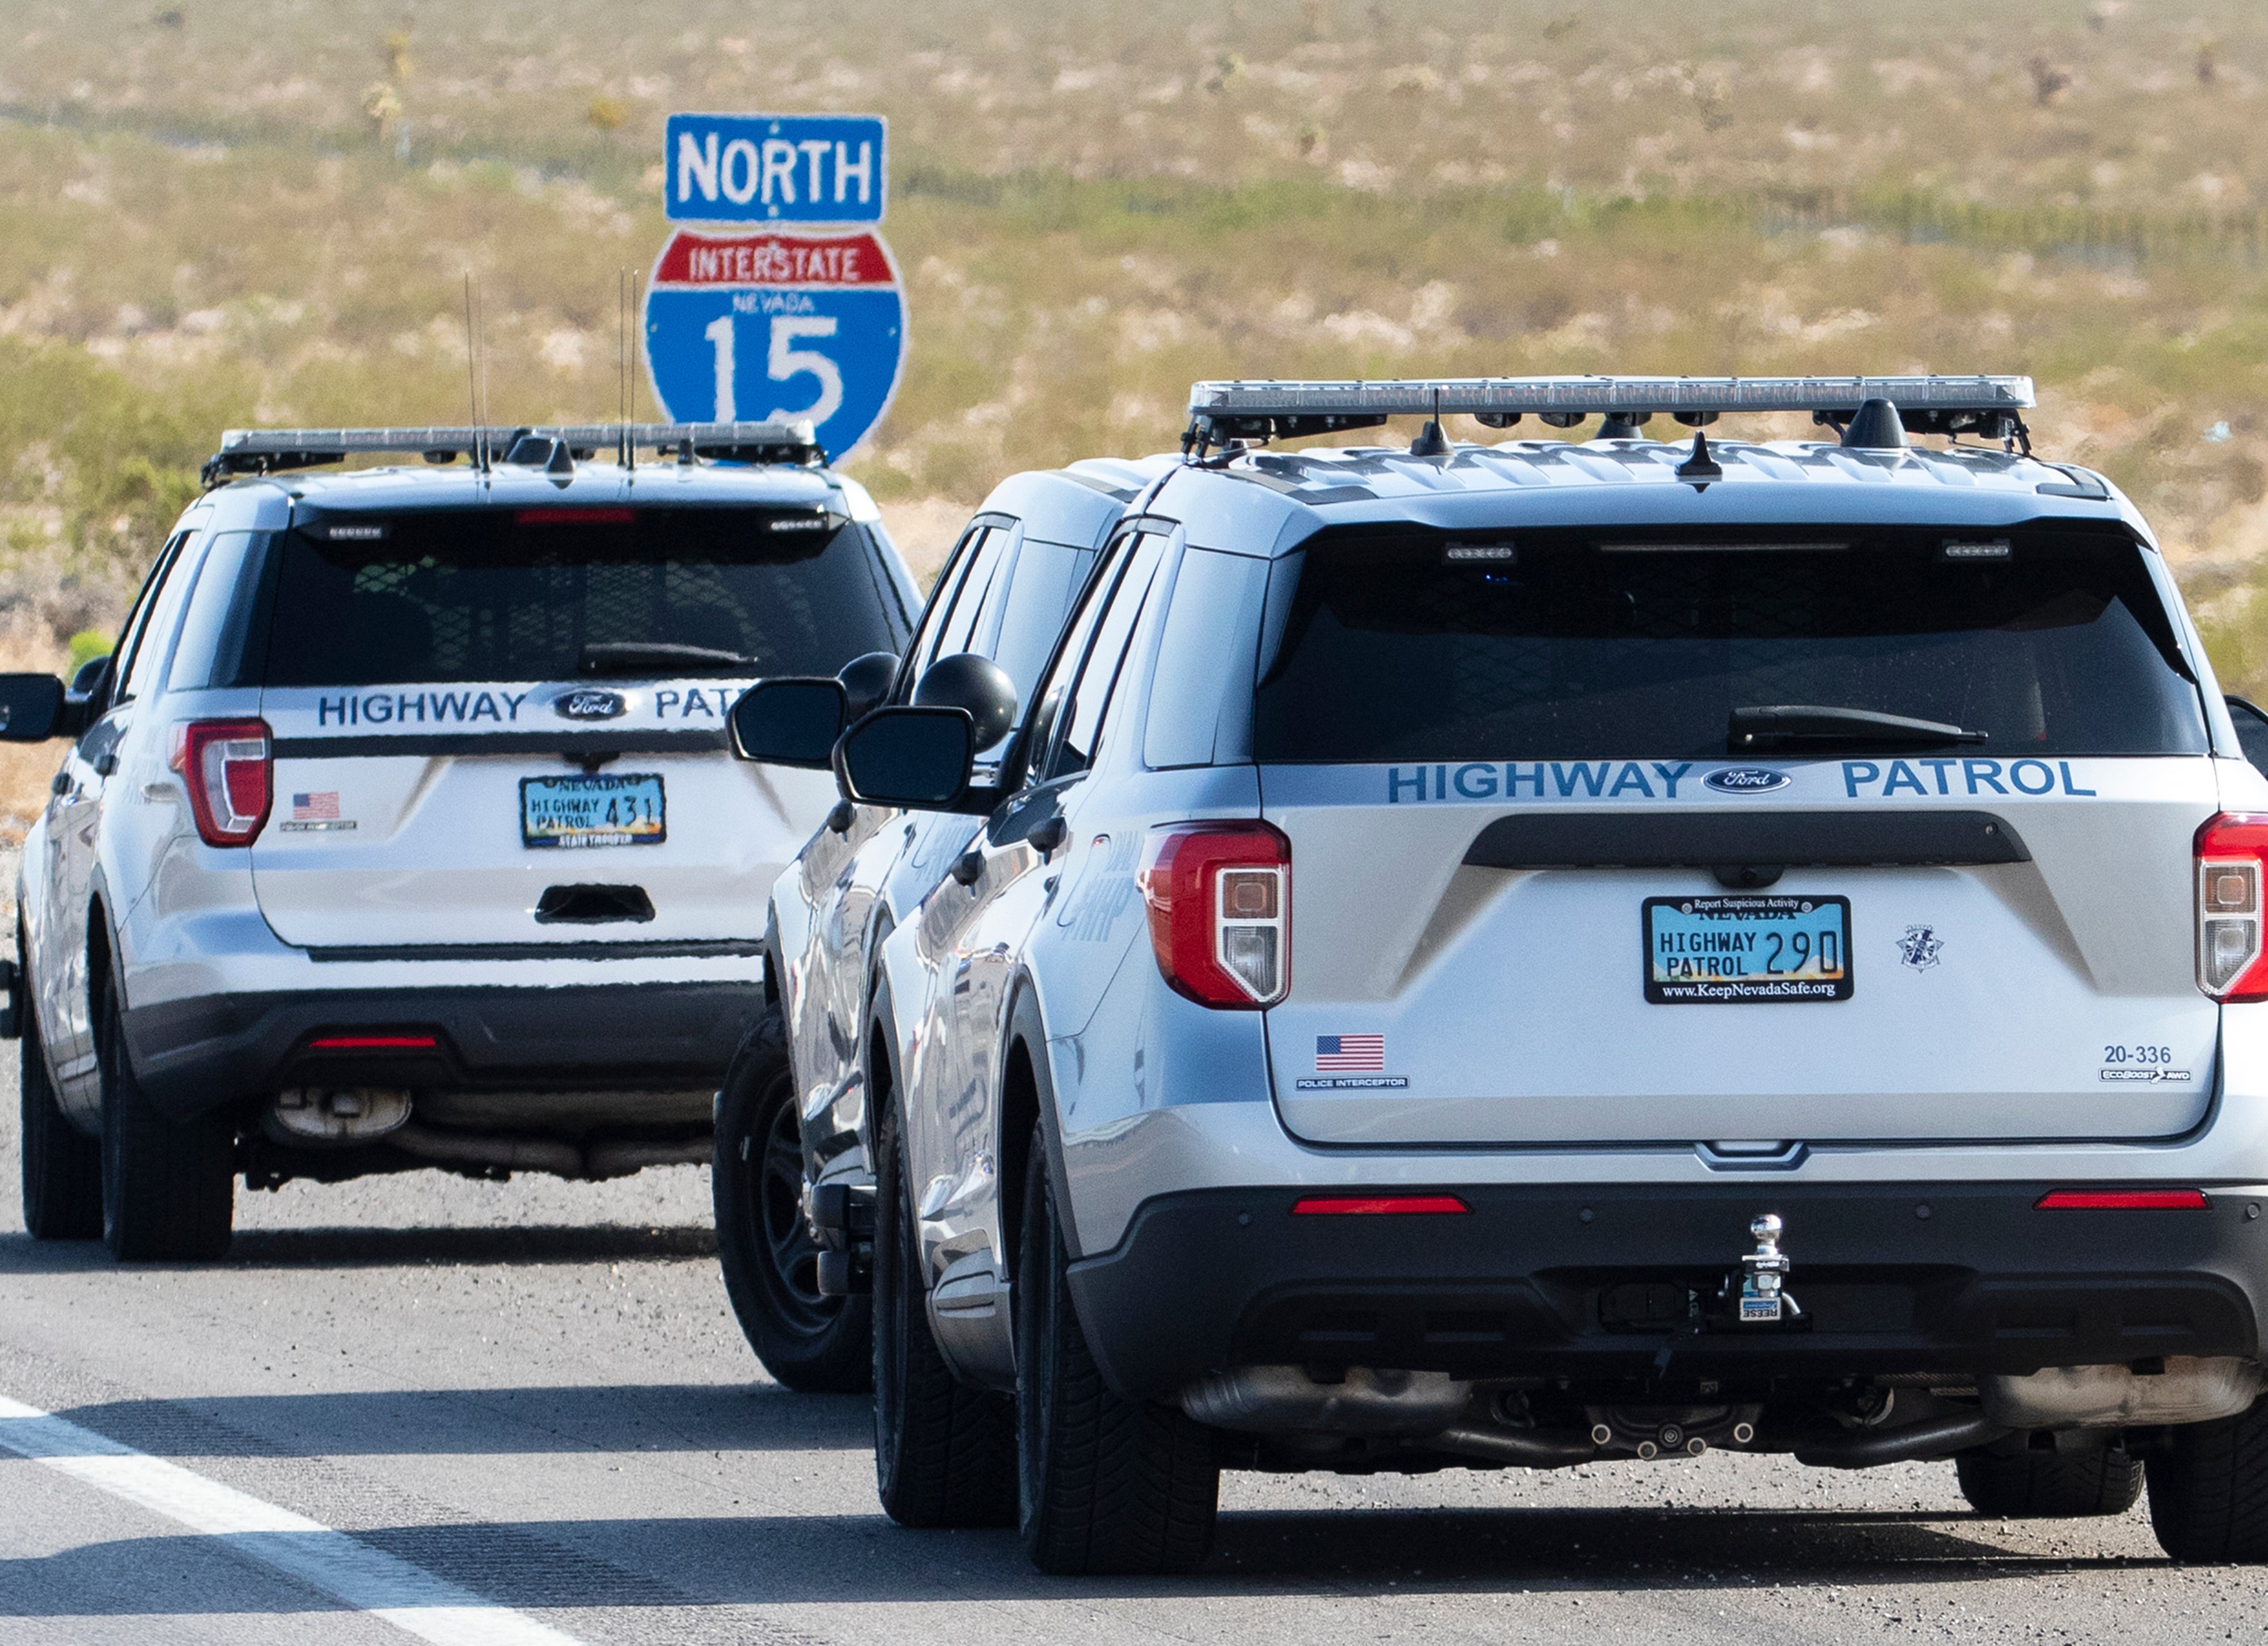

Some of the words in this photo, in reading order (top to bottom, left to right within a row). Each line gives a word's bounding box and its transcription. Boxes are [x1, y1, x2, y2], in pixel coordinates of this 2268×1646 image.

[678, 132, 871, 205] NORTH
[689, 247, 861, 281] INTERSTATE
[733, 294, 815, 314] NEVADA
[704, 315, 844, 428] 15
[319, 692, 527, 726] HIGHWAY
[655, 688, 748, 718] PAT
[568, 694, 615, 715] Ford
[1388, 761, 1693, 803] HIGHWAY
[1841, 759, 2097, 798] PATROL
[1723, 768, 1770, 788] Ford
[532, 798, 599, 813] HIGHWAY
[606, 796, 651, 828] 431
[536, 815, 594, 828] PATROL
[1694, 899, 1721, 910] Report
[1723, 898, 1765, 909] Suspicious
[1767, 898, 1799, 909] Activity
[1660, 932, 1757, 952] HIGHWAY
[1766, 931, 1838, 974] 290
[1666, 956, 1748, 976] PATROL
[1662, 982, 1836, 998] www.KeepNevadaSafe.org
[2104, 1046, 2171, 1063] 20-336
[1298, 1080, 1332, 1088] POLICE
[1335, 1078, 1406, 1088] INTERCEPTOR
[1743, 1309, 1778, 1318] REESE
